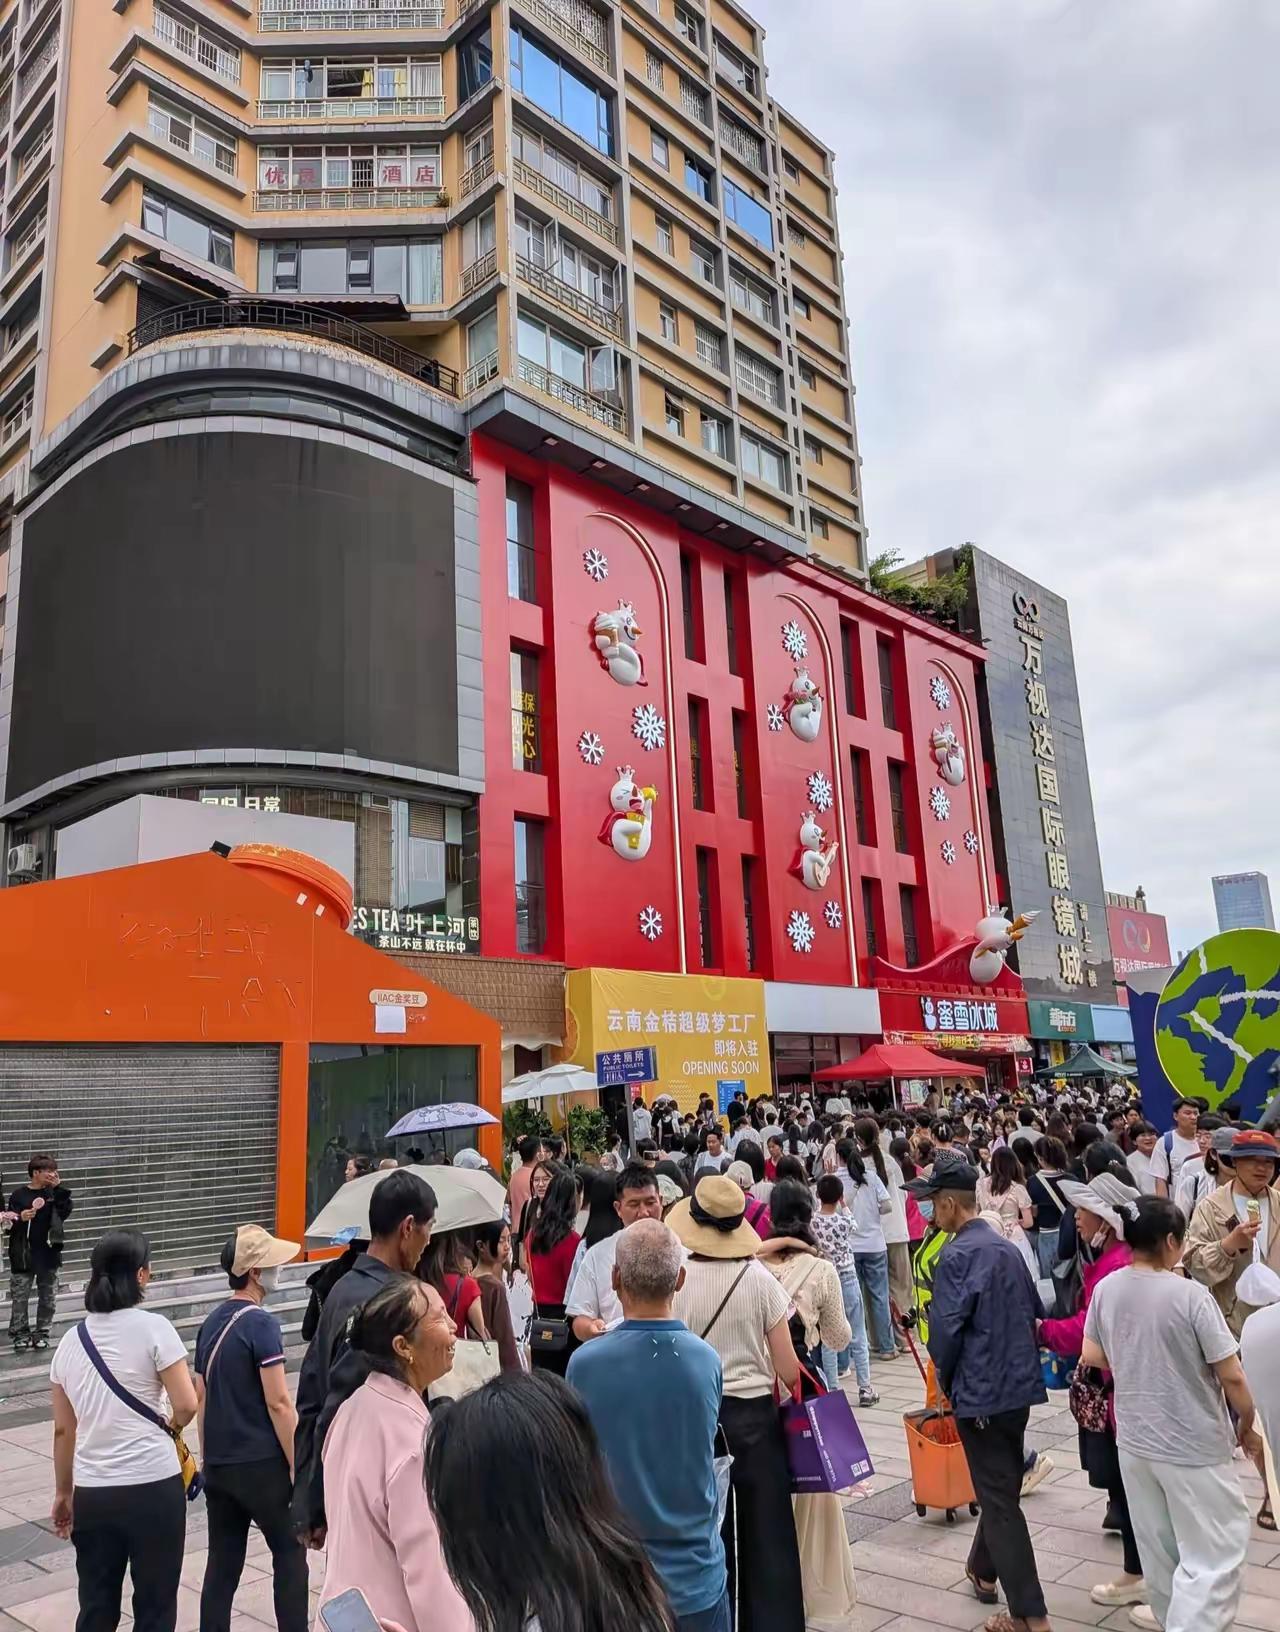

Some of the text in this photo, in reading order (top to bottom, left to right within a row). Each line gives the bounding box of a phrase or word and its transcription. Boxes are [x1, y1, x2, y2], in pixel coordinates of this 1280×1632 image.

[1019, 635, 1083, 985] 万视达国际眼镜城
[372, 908, 399, 933] TEA
[406, 913, 466, 939] 叶上河
[607, 1008, 756, 1034] 云南金桔超级梦工厂
[937, 1000, 998, 1031] 蜜雪冰城
[602, 1050, 644, 1066] 公共厕所
[714, 1040, 759, 1057] 即将入驻
[603, 1061, 645, 1072] PUBLIC TOILETS
[682, 1060, 760, 1076] OPENING SOON
